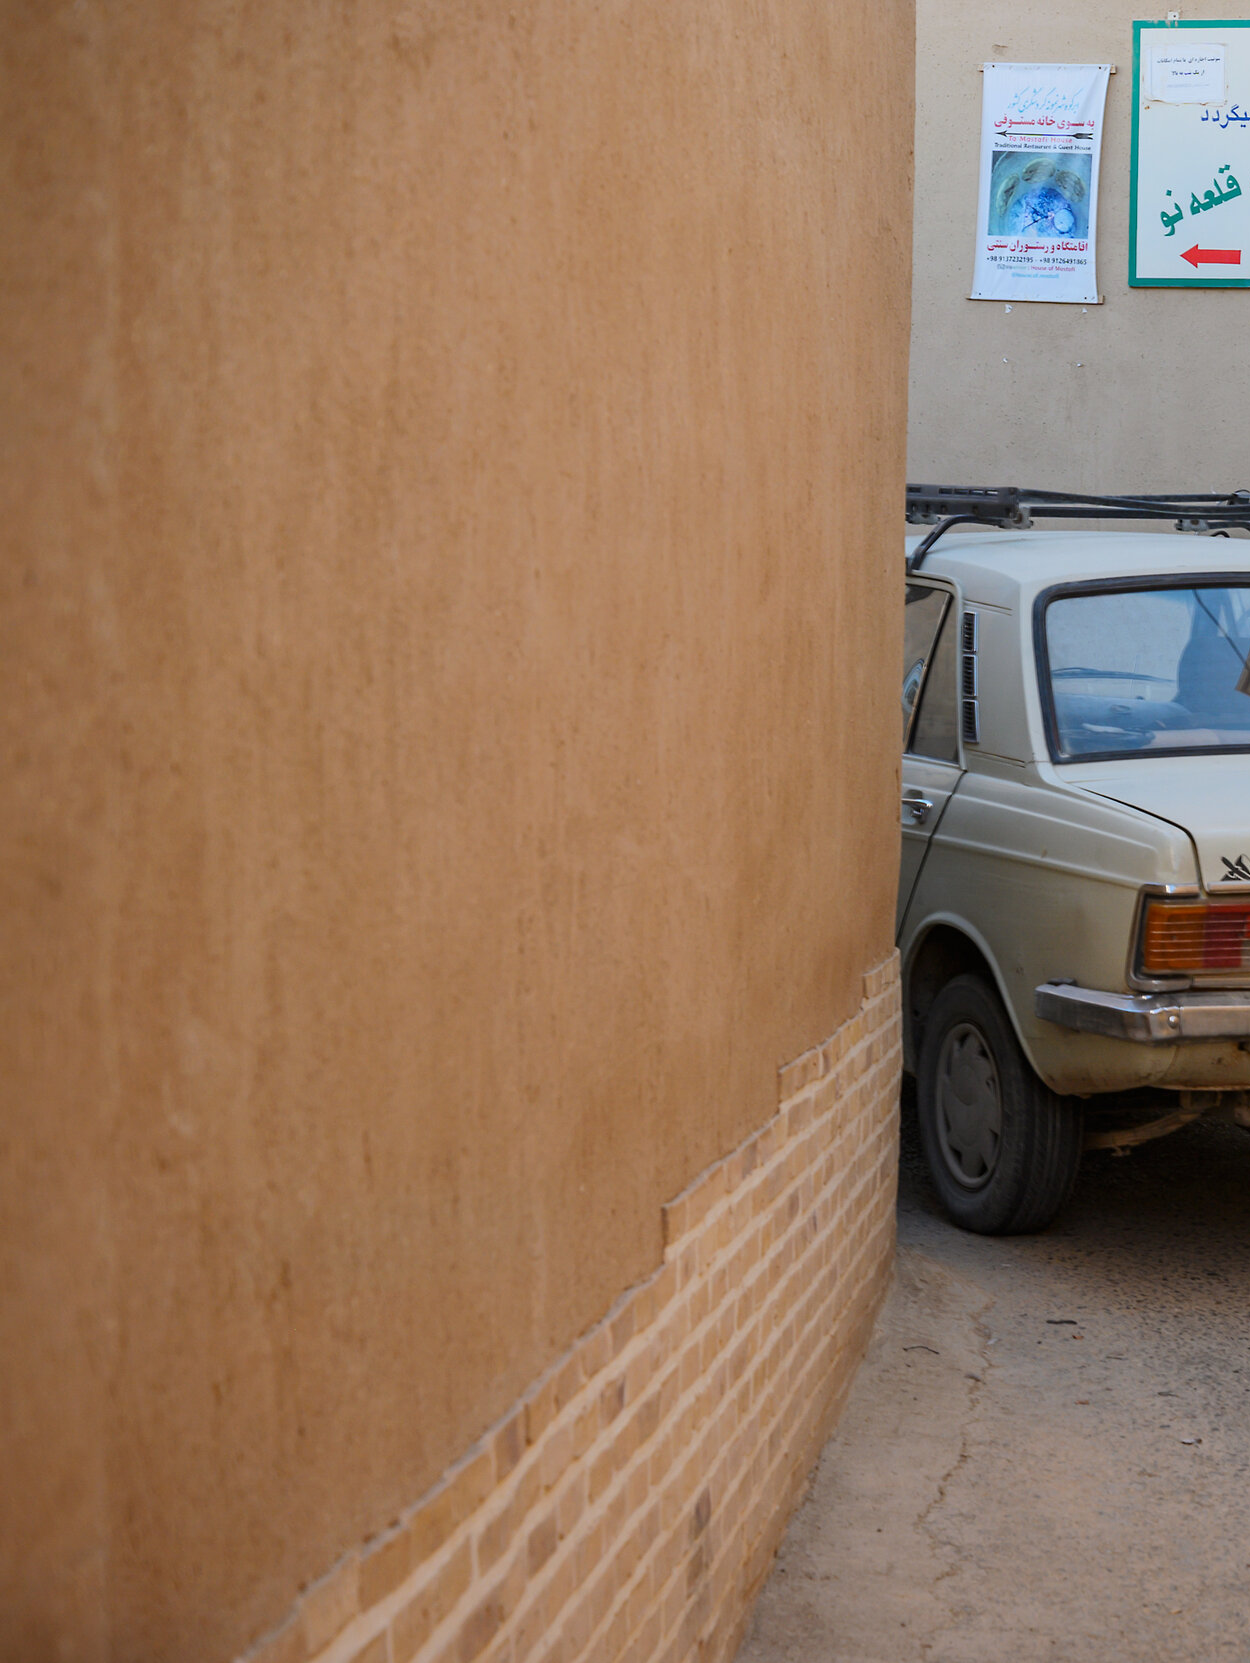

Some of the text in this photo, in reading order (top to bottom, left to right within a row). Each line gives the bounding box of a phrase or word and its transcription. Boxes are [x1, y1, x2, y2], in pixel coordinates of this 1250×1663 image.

[993, 113, 1036, 128] مستوفی
[1036, 115, 1056, 126] خانه
[1189, 164, 1243, 216] قلعه
[1159, 189, 1184, 237] نو
